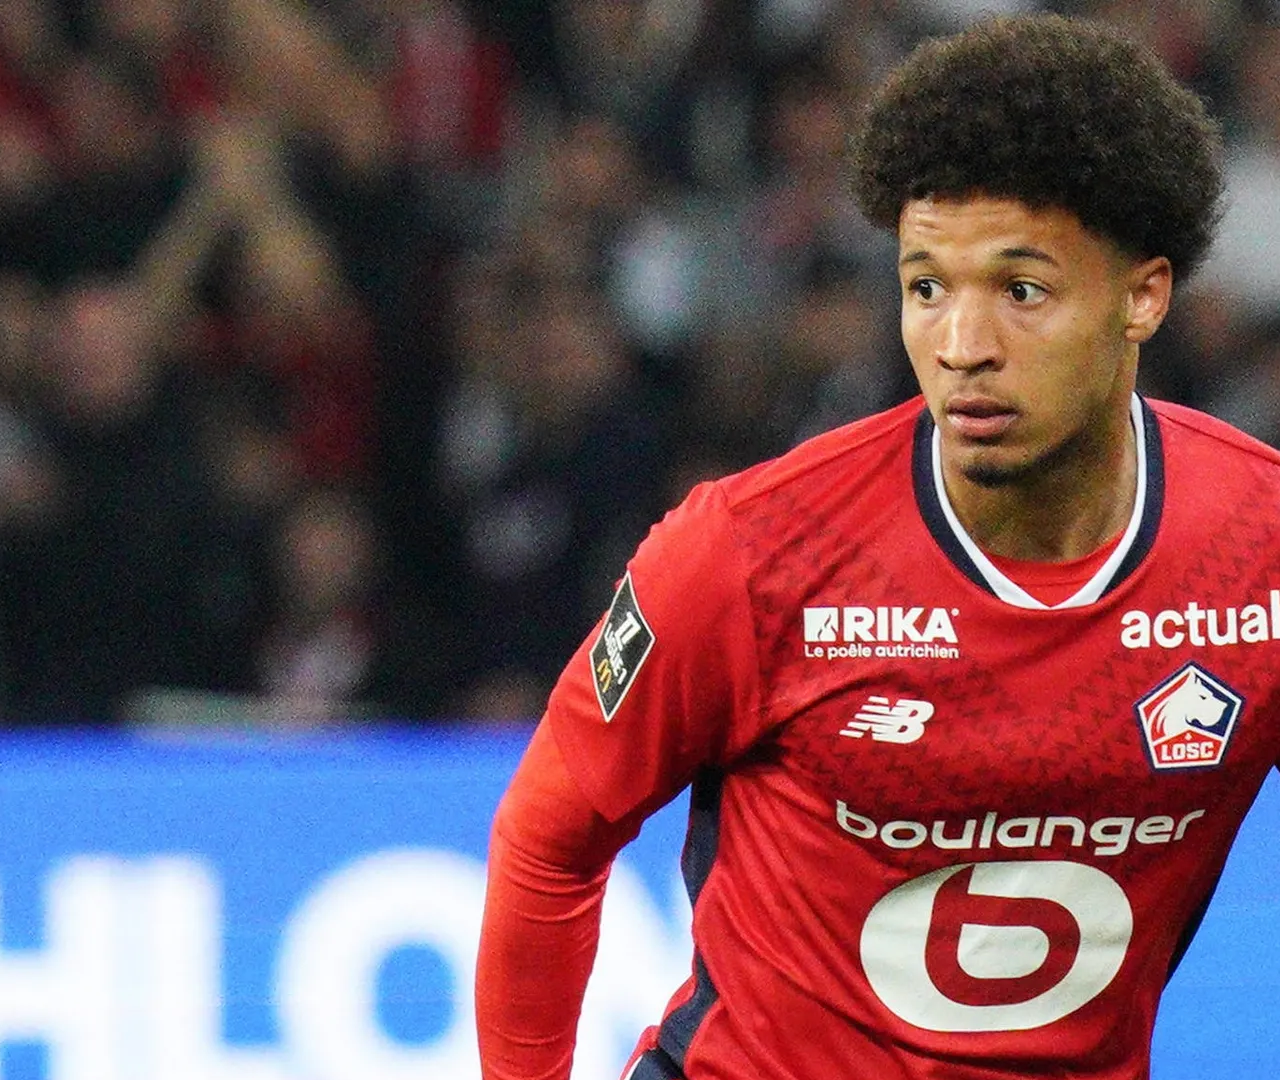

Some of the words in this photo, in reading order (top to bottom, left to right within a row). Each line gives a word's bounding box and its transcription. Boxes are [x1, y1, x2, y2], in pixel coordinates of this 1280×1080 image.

[843, 606, 959, 643] RIKA
[804, 643, 824, 658] Le
[827, 643, 872, 661] poêle
[874, 643, 960, 660] autrichien
[1161, 741, 1214, 761] LOSC
[835, 799, 1207, 857] boulanger
